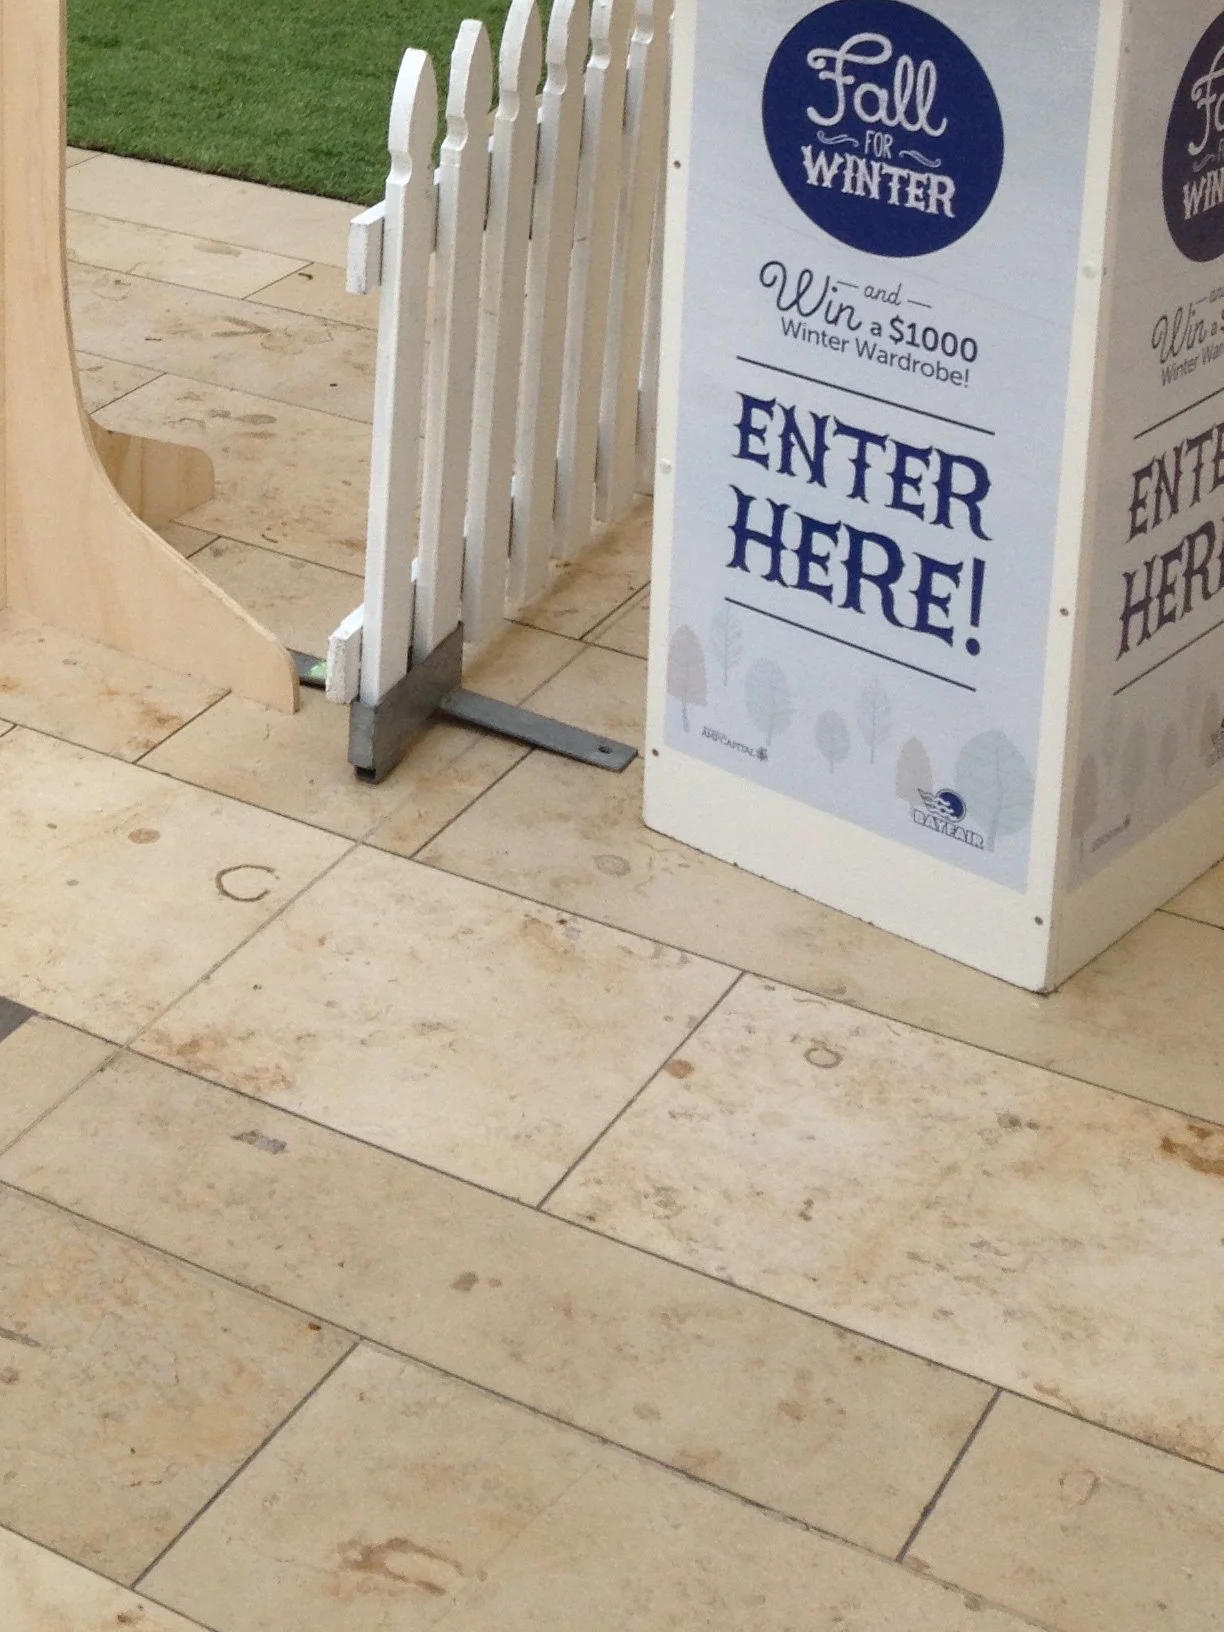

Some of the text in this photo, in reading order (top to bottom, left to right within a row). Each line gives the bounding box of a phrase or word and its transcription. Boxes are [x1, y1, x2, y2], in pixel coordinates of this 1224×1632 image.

[806, 32, 948, 137] Fall
[864, 129, 893, 160] FOR
[801, 144, 956, 219] WINTER
[759, 260, 979, 364] Win a $1000
[864, 282, 903, 307] and
[780, 316, 970, 389] Winter Wardrobe!
[1151, 302, 1207, 364] Win
[1161, 355, 1200, 387] Winter
[731, 391, 994, 542] ENTER
[725, 483, 989, 658] HERE!
[912, 807, 985, 852] BAYFAIR
